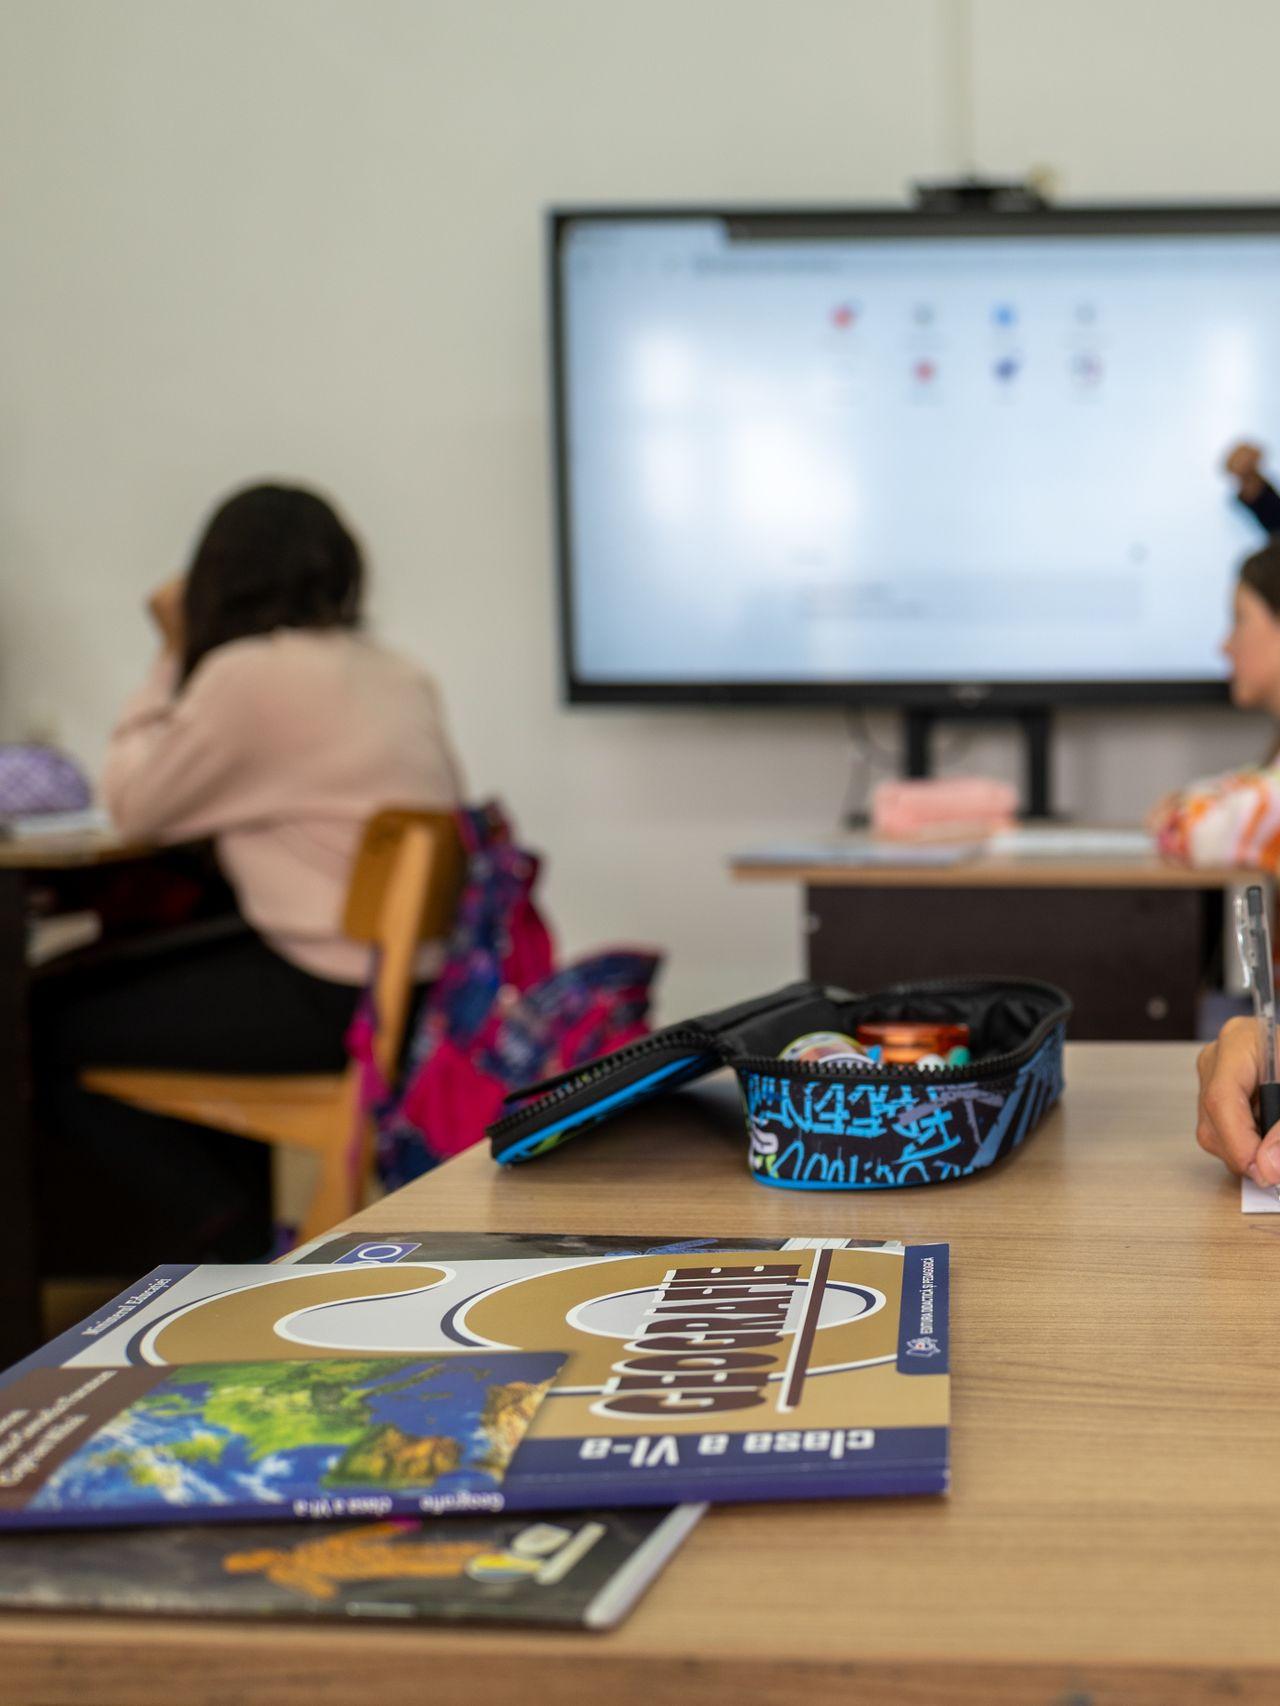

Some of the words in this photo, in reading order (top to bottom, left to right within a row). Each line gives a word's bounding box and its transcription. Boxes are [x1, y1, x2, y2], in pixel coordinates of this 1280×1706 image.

[920, 1312, 933, 1334] EDITURA
[593, 1263, 803, 1419] GEOGRAFIE
[579, 1435, 680, 1468] VI-a
[697, 1434, 729, 1456] a
[743, 1429, 875, 1459] clasa
